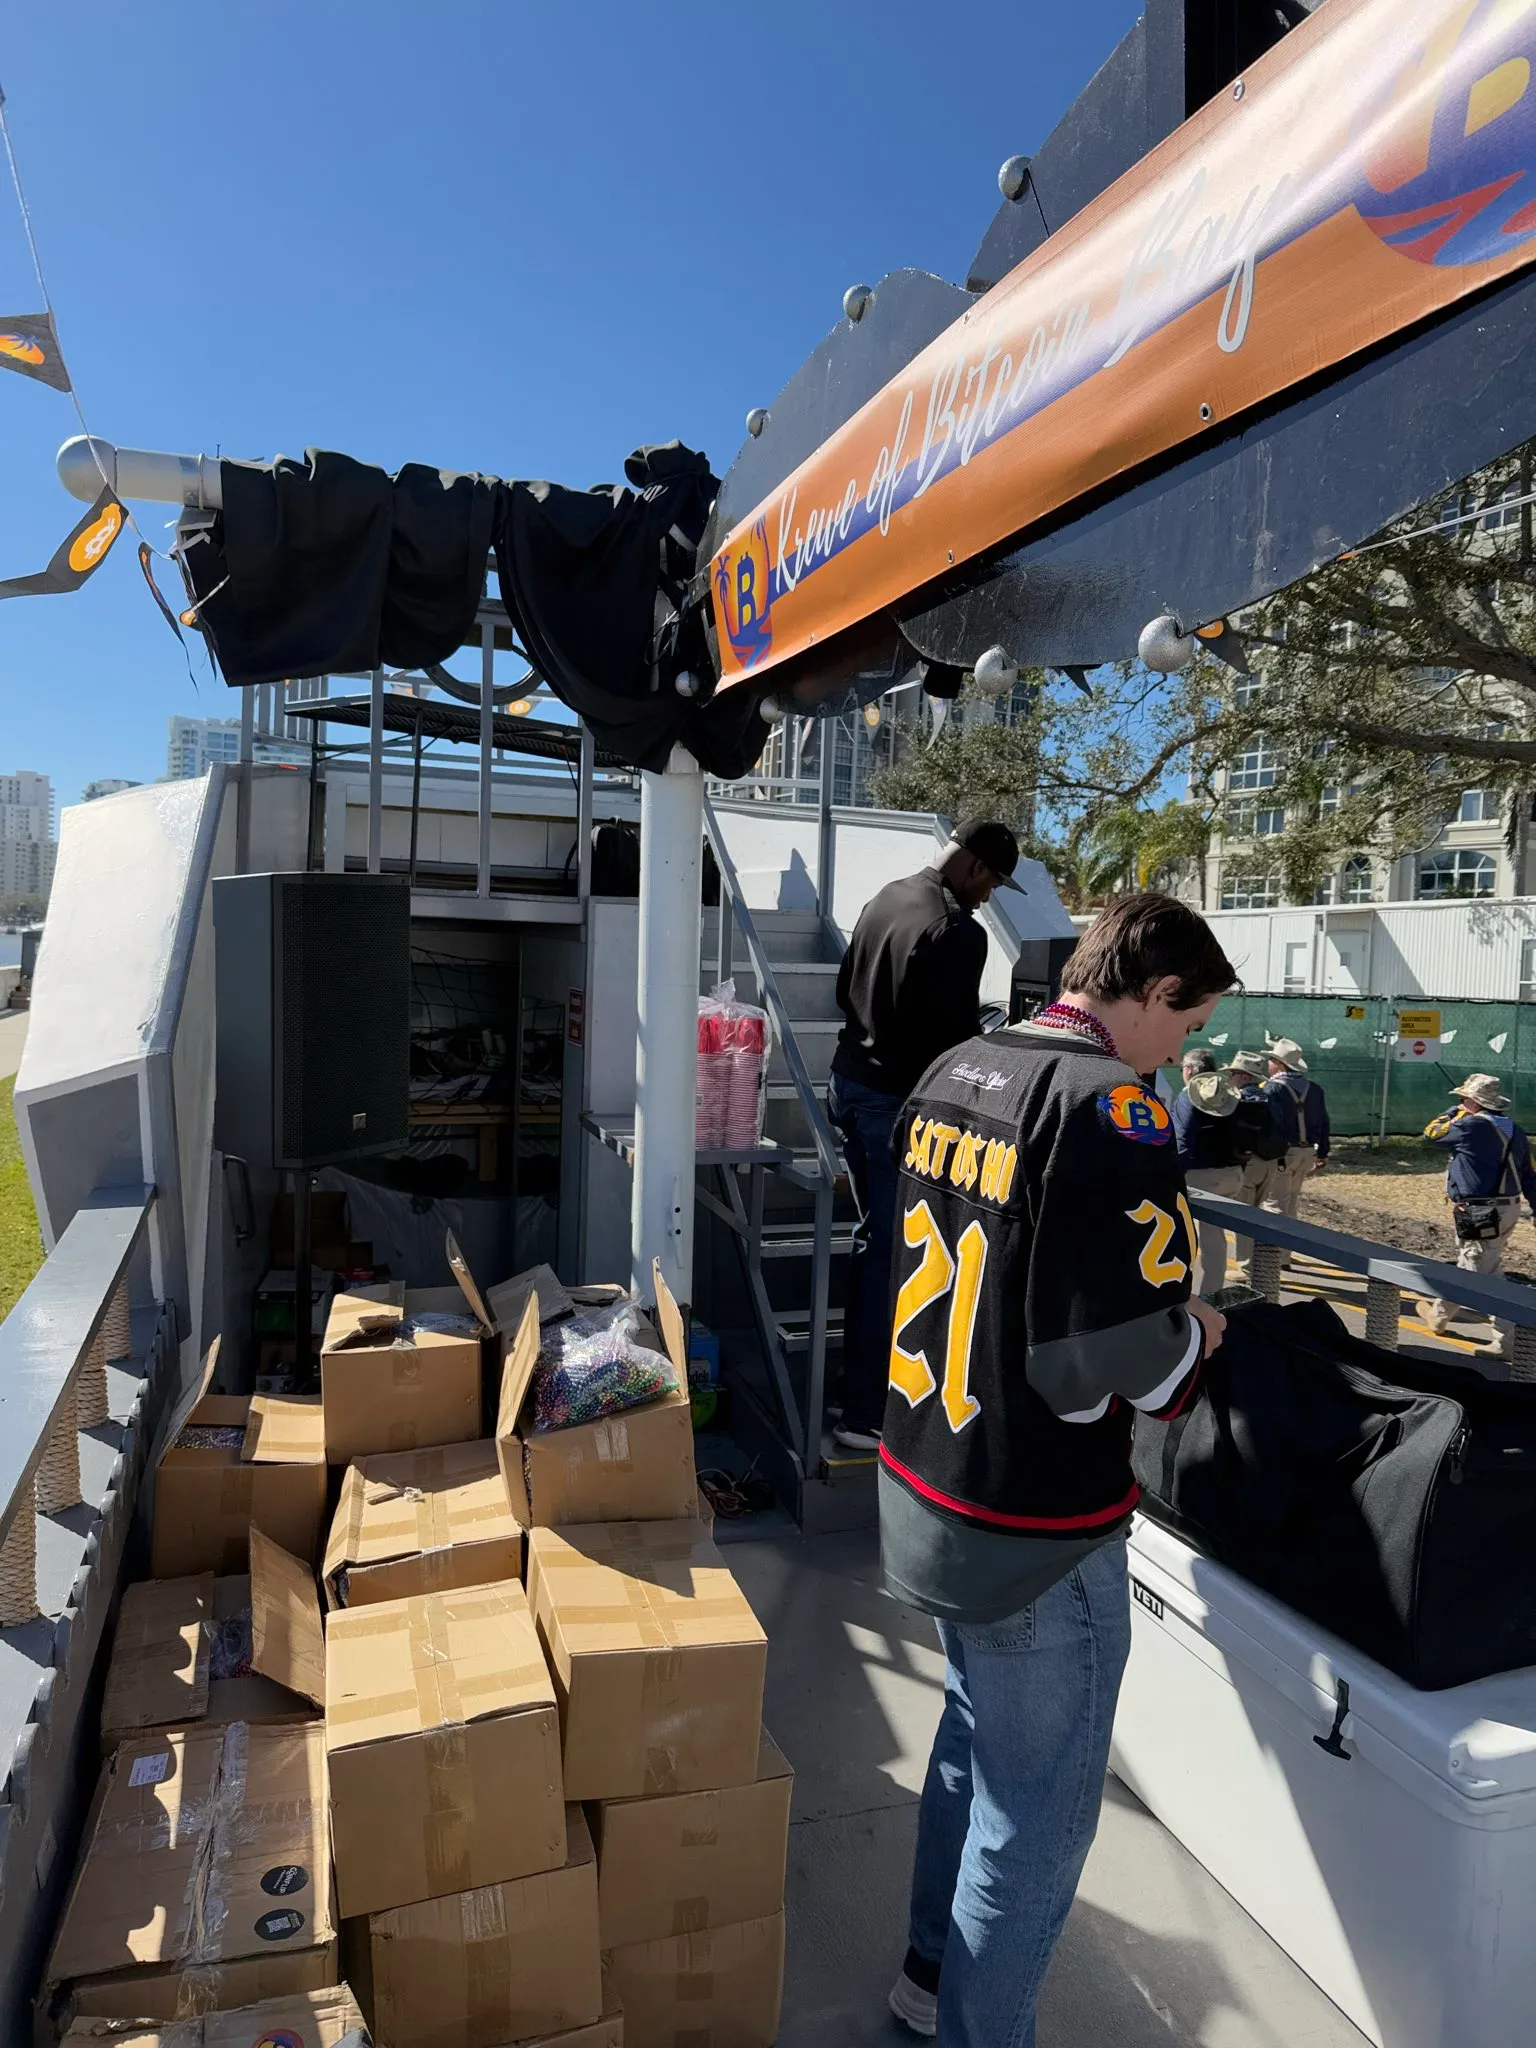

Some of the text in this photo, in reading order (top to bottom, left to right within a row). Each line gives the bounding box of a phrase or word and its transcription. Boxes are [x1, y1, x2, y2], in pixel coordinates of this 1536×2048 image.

[776, 166, 1298, 592] Krewe of Bitcoin Bay
[905, 1114, 1019, 1205] SATOSHI
[888, 1199, 989, 1434] 21
[1134, 1582, 1162, 1618] YETI
